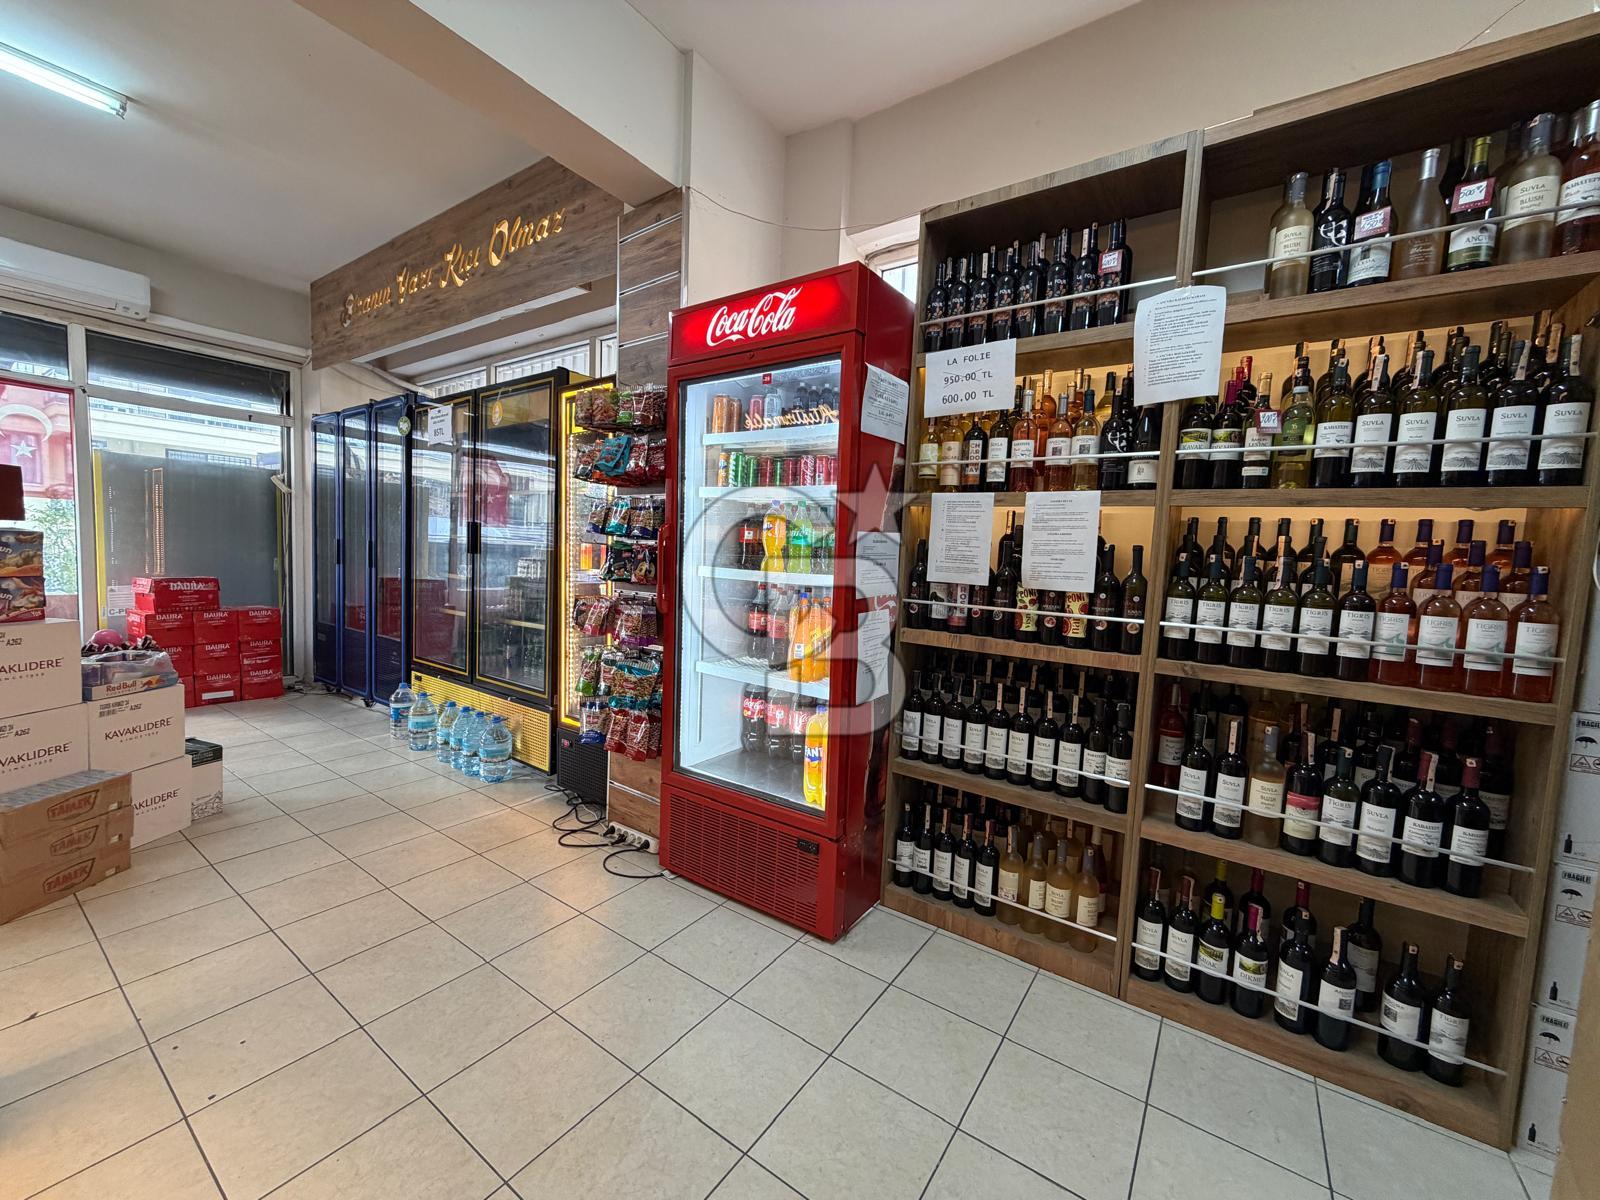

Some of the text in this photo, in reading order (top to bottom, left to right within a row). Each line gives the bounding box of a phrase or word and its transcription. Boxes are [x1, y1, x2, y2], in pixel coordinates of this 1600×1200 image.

[706, 285, 804, 347] Coca-Cola
[946, 352, 991, 366] LA FOLIE
[944, 370, 993, 386] 950.00 TL
[942, 390, 994, 405] 600.00 TL
[6, 638, 22, 646] A262
[106, 681, 137, 693] Red Bull
[14, 728, 30, 737] A262
[104, 717, 172, 741] KAVAKLIDERE
[50, 796, 92, 818] TAMEK
[1366, 808, 1389, 820] SUVLA
[46, 865, 88, 892] TAMEK
[1564, 872, 1590, 884] FRAGILE
[1542, 1016, 1568, 1029] FRAGILE
